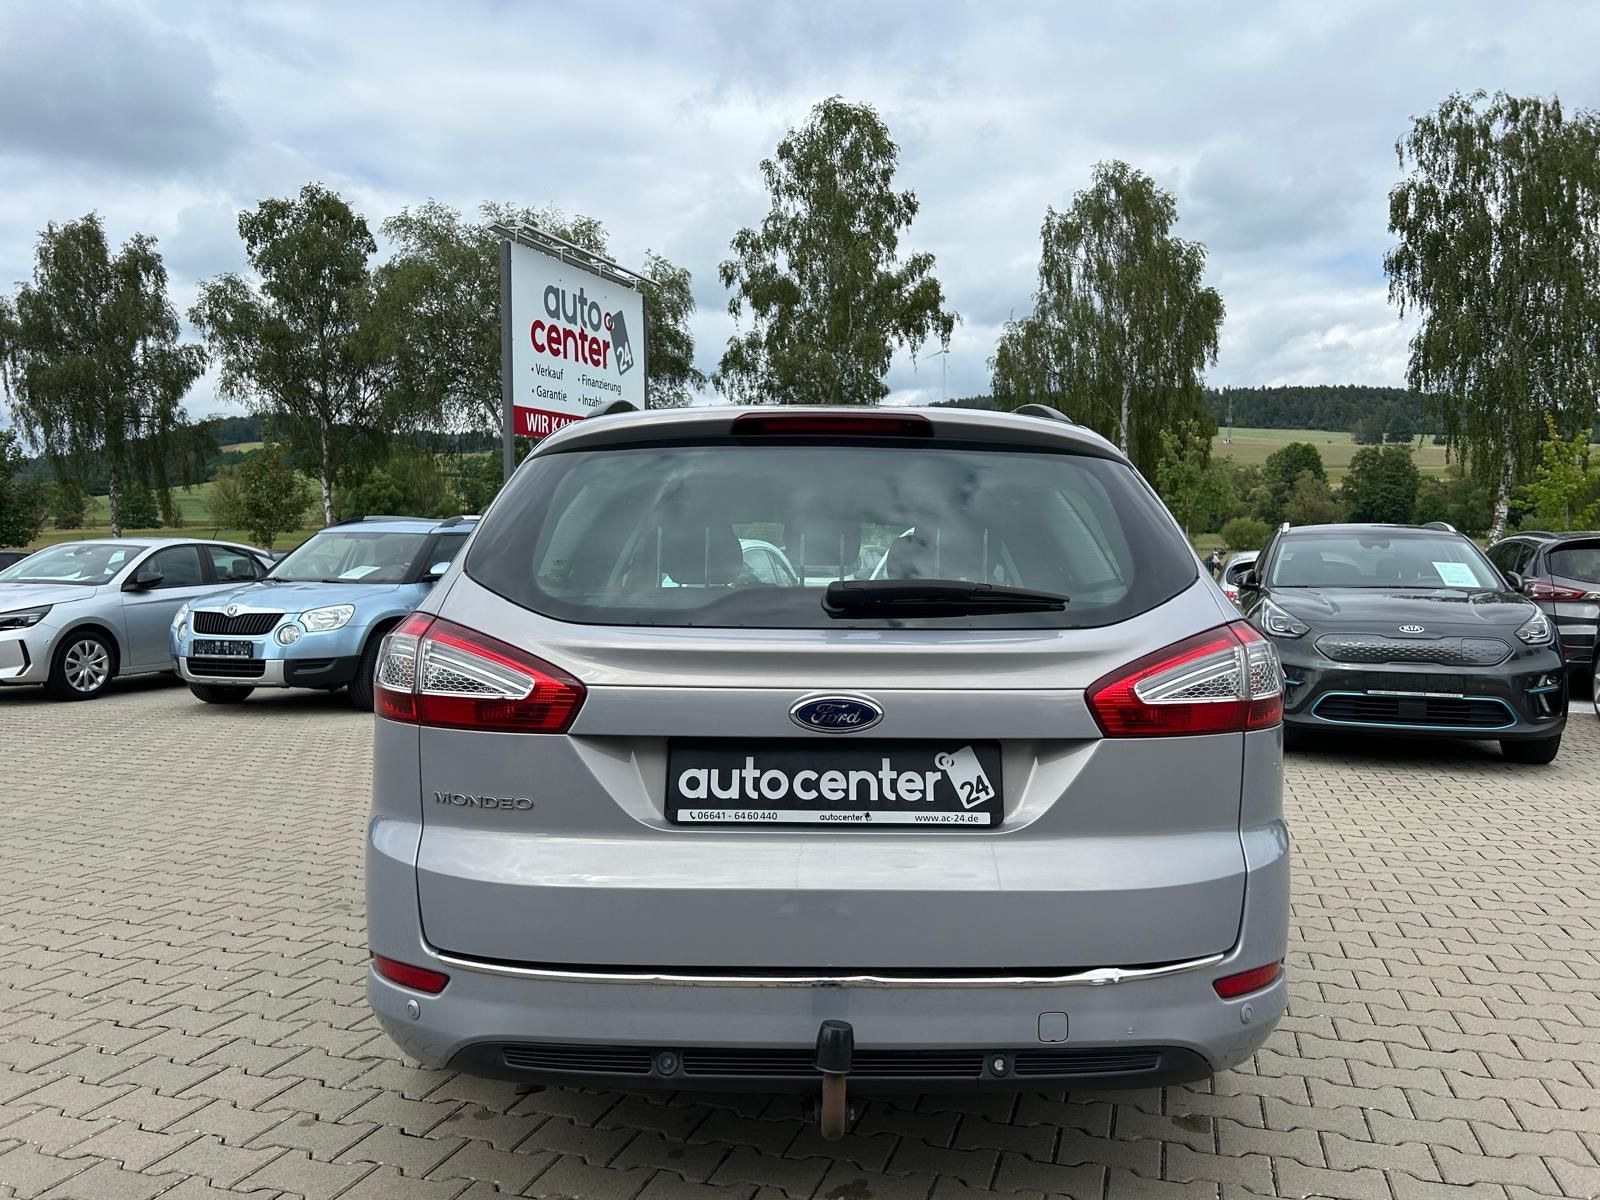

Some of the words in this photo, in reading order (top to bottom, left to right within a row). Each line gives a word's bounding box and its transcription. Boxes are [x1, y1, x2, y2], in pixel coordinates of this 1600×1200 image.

[544, 284, 601, 332] auto
[531, 319, 610, 369] center
[616, 341, 632, 370] 24
[535, 363, 564, 380] Verkauf
[536, 385, 567, 402] Garantie
[581, 374, 622, 396] Finanzierung
[525, 412, 549, 433] WIR
[811, 703, 861, 724] Ford
[959, 774, 990, 805] 24
[432, 790, 535, 811] MONDEO
[697, 811, 726, 820] 06641
[819, 813, 863, 822] autocenter
[914, 814, 979, 823] www.ac-24.de
